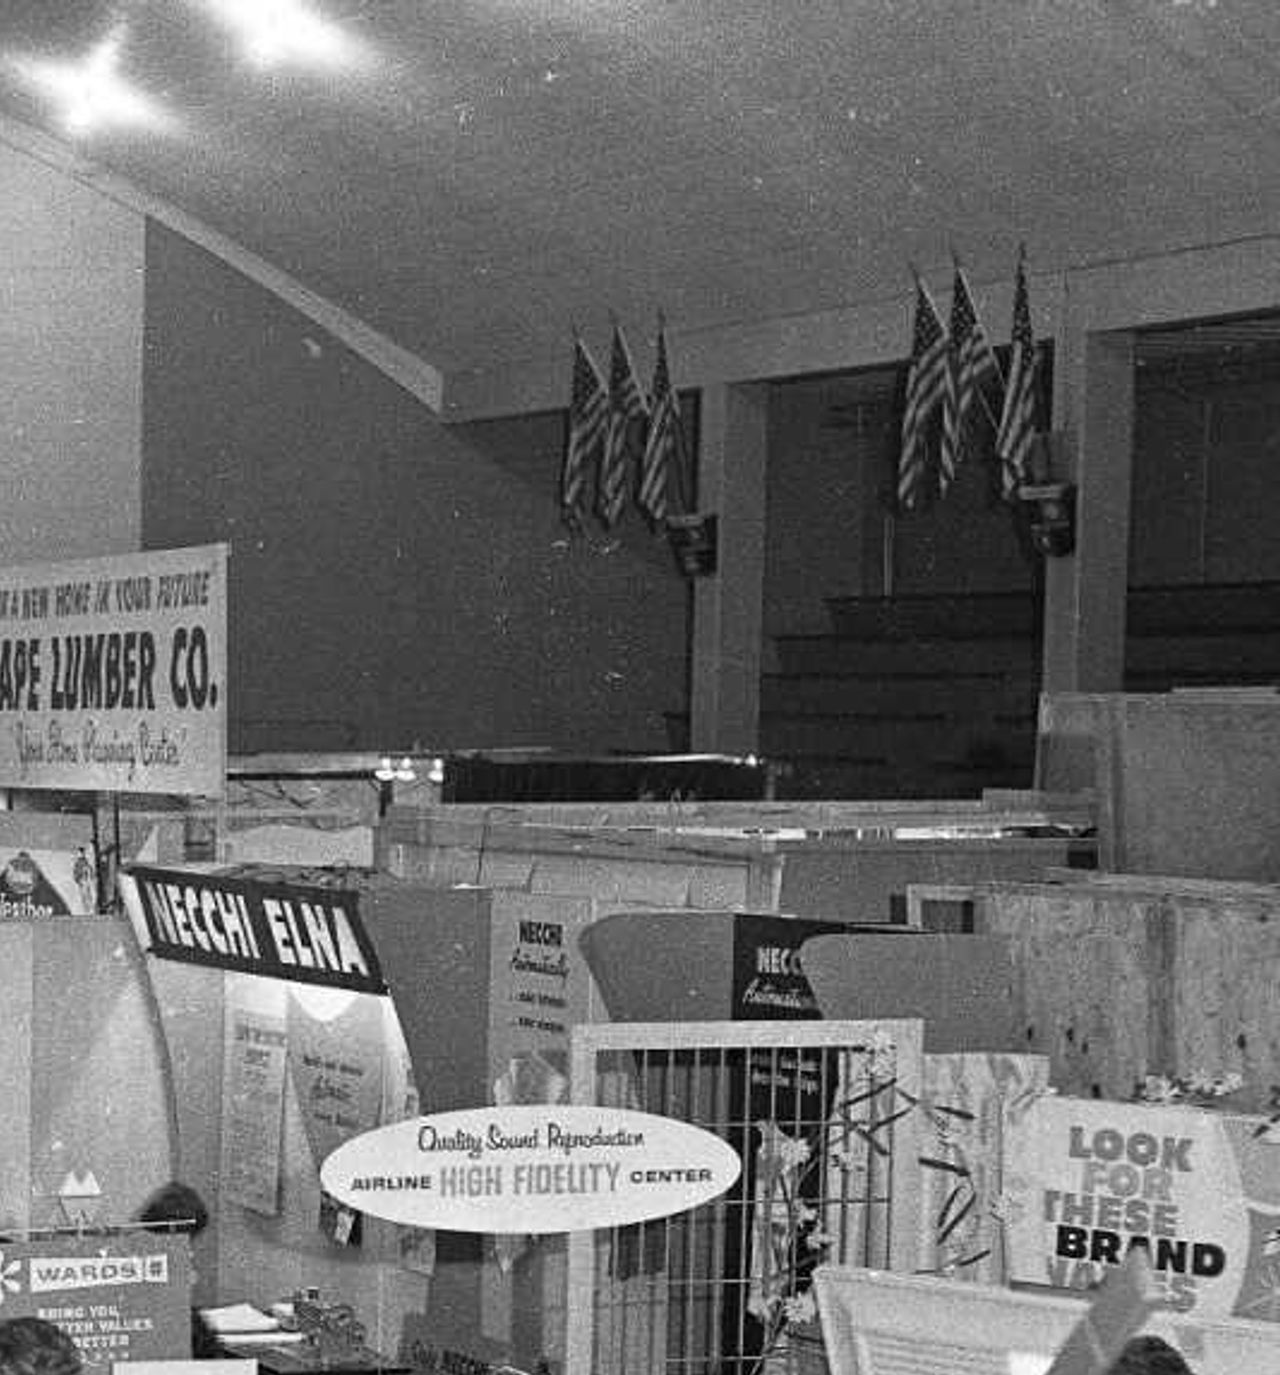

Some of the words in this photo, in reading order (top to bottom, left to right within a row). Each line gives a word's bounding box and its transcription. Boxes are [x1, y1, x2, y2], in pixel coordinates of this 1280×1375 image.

[115, 577, 151, 612] YOUR
[51, 632, 156, 710] LUMBER
[170, 627, 217, 710] CO.
[144, 882, 261, 959] NECCHI
[263, 899, 369, 977] ELNA
[757, 947, 804, 976] NECC
[417, 1124, 482, 1158] Quality
[486, 1123, 538, 1151] Sound
[547, 1122, 643, 1155] Reproduction
[1069, 1126, 1193, 1172] LOOK
[351, 1175, 432, 1192] AIRLINE
[439, 1164, 502, 1198] HIGH
[513, 1162, 620, 1196] FIDELITY
[629, 1168, 713, 1184] CENTER
[1084, 1161, 1172, 1201] FOR
[1044, 1190, 1179, 1237] THESE
[37, 1264, 136, 1282] WARDS
